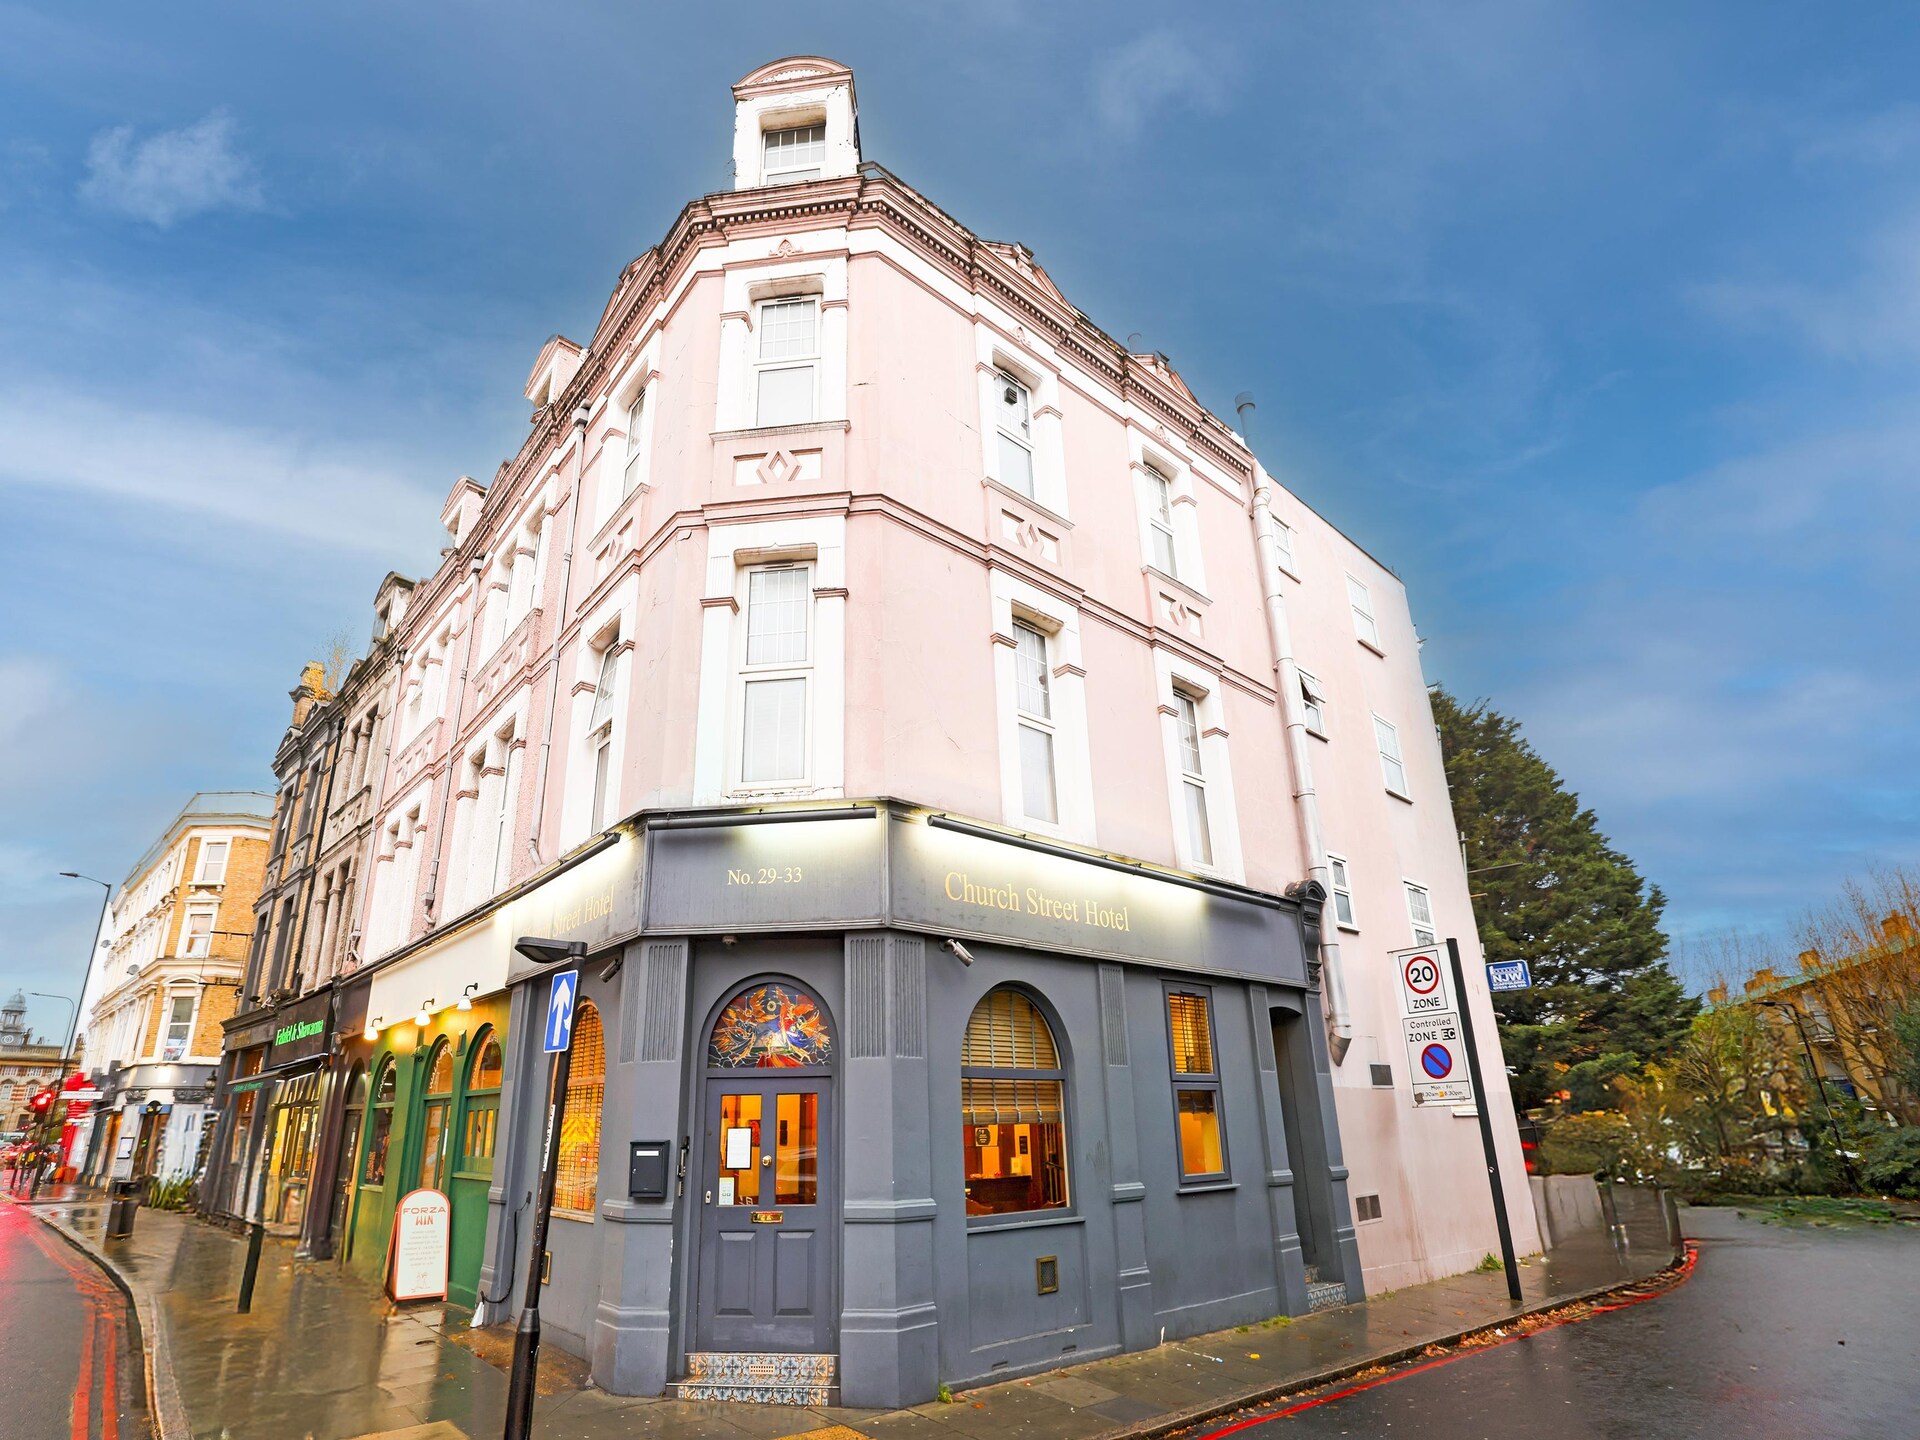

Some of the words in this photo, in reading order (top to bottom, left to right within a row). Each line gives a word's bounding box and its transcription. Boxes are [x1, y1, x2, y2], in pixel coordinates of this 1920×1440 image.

[727, 869, 754, 885] No.
[757, 866, 802, 884] 29-33
[945, 871, 1021, 912] Church
[1026, 887, 1080, 922] Street
[1084, 899, 1130, 932] Hotel
[552, 904, 581, 938] Street
[583, 884, 614, 924] Hotel
[1410, 965, 1433, 983] 20
[1492, 972, 1522, 983] NJW
[1413, 997, 1440, 1009] ZONE
[1409, 1018, 1451, 1029] Controlled
[1408, 1031, 1438, 1042] ZONE
[1441, 1028, 1456, 1041] EC
[403, 1206, 446, 1215] FORZA
[415, 1215, 433, 1226] WIN
